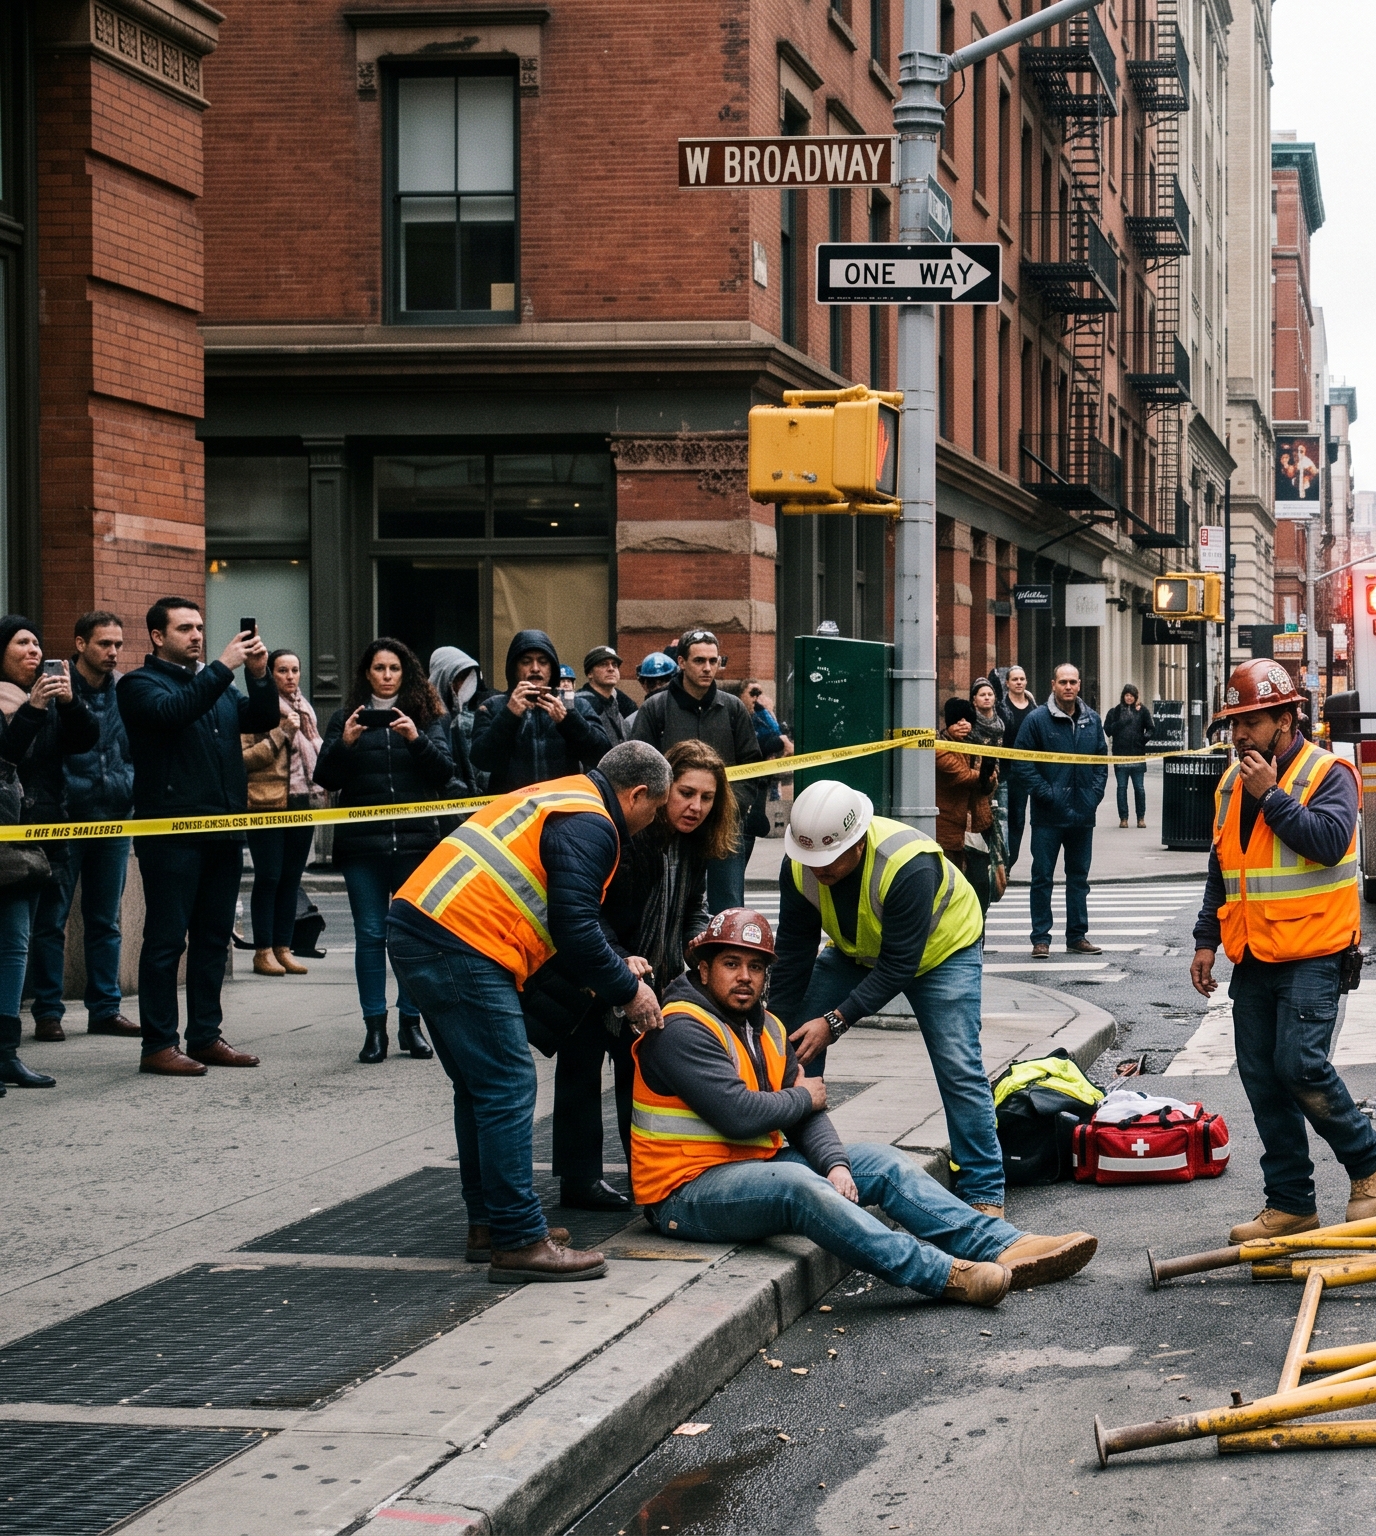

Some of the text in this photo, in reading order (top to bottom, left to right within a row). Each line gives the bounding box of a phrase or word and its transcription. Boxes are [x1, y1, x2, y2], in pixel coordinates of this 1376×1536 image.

[685, 143, 885, 184] W BROADWAY
[844, 263, 974, 285] ONE WAY
